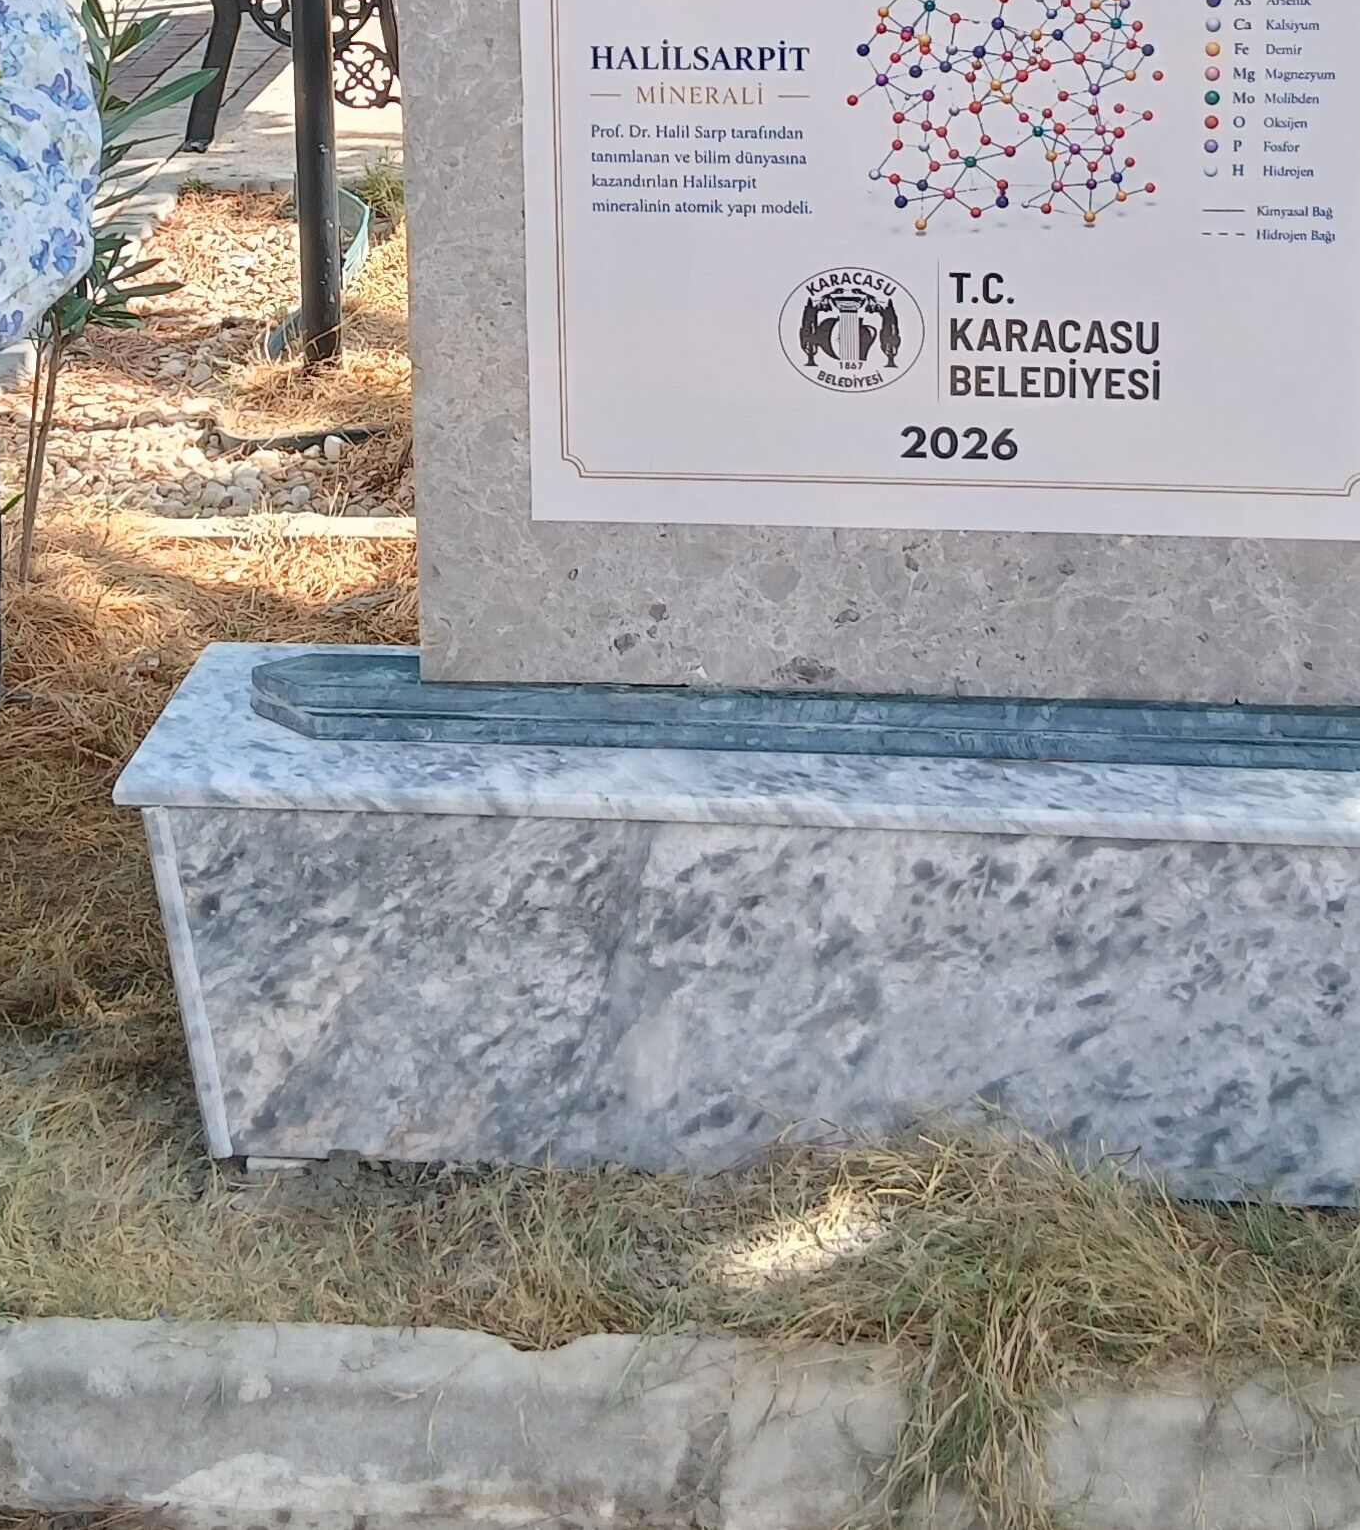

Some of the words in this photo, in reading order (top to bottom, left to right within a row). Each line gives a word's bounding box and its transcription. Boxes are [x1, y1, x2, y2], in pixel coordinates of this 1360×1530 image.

[1233, 17, 1253, 31] Ca
[1266, 18, 1320, 34] Kalsiyum
[590, 39, 810, 71] HALİLSARPİT
[1234, 42, 1250, 56] Fe
[1265, 43, 1303, 56] Demir
[1233, 67, 1256, 83] Mg
[1265, 68, 1336, 83] Magnezyum
[636, 81, 763, 105] MİNERALİ
[1232, 91, 1256, 104] Mo
[1264, 92, 1320, 105] Molibden
[591, 123, 624, 139] Prof.
[629, 124, 651, 139] Dr.
[655, 124, 690, 139] Halil
[694, 125, 727, 143] Sarp
[730, 125, 803, 140] tarafından
[1232, 115, 1246, 129] O
[1263, 116, 1308, 132] Oksijen
[1233, 139, 1243, 153] P
[1263, 140, 1301, 153] Fosfor
[591, 149, 670, 164] tanımlanan
[674, 153, 691, 164] ve
[694, 149, 731, 164] bilim
[735, 150, 807, 168] dünyasına
[1232, 163, 1244, 177] H
[1263, 165, 1315, 180] Hidrojen
[591, 173, 679, 188] kazandırılan
[683, 174, 757, 193] Halilsarpit
[592, 198, 671, 213] mineralinin
[674, 199, 724, 214] atomik
[727, 203, 757, 218] yapı
[761, 200, 813, 215] modeli.
[804, 272, 898, 297] KARACASU
[948, 272, 1015, 305] T.C.
[950, 317, 1160, 355] KARACASU
[839, 361, 864, 371] 1867
[816, 369, 884, 389] BELEDİYESİ
[950, 357, 1161, 401] BELEDİYESİ
[900, 425, 1018, 461] 2026
